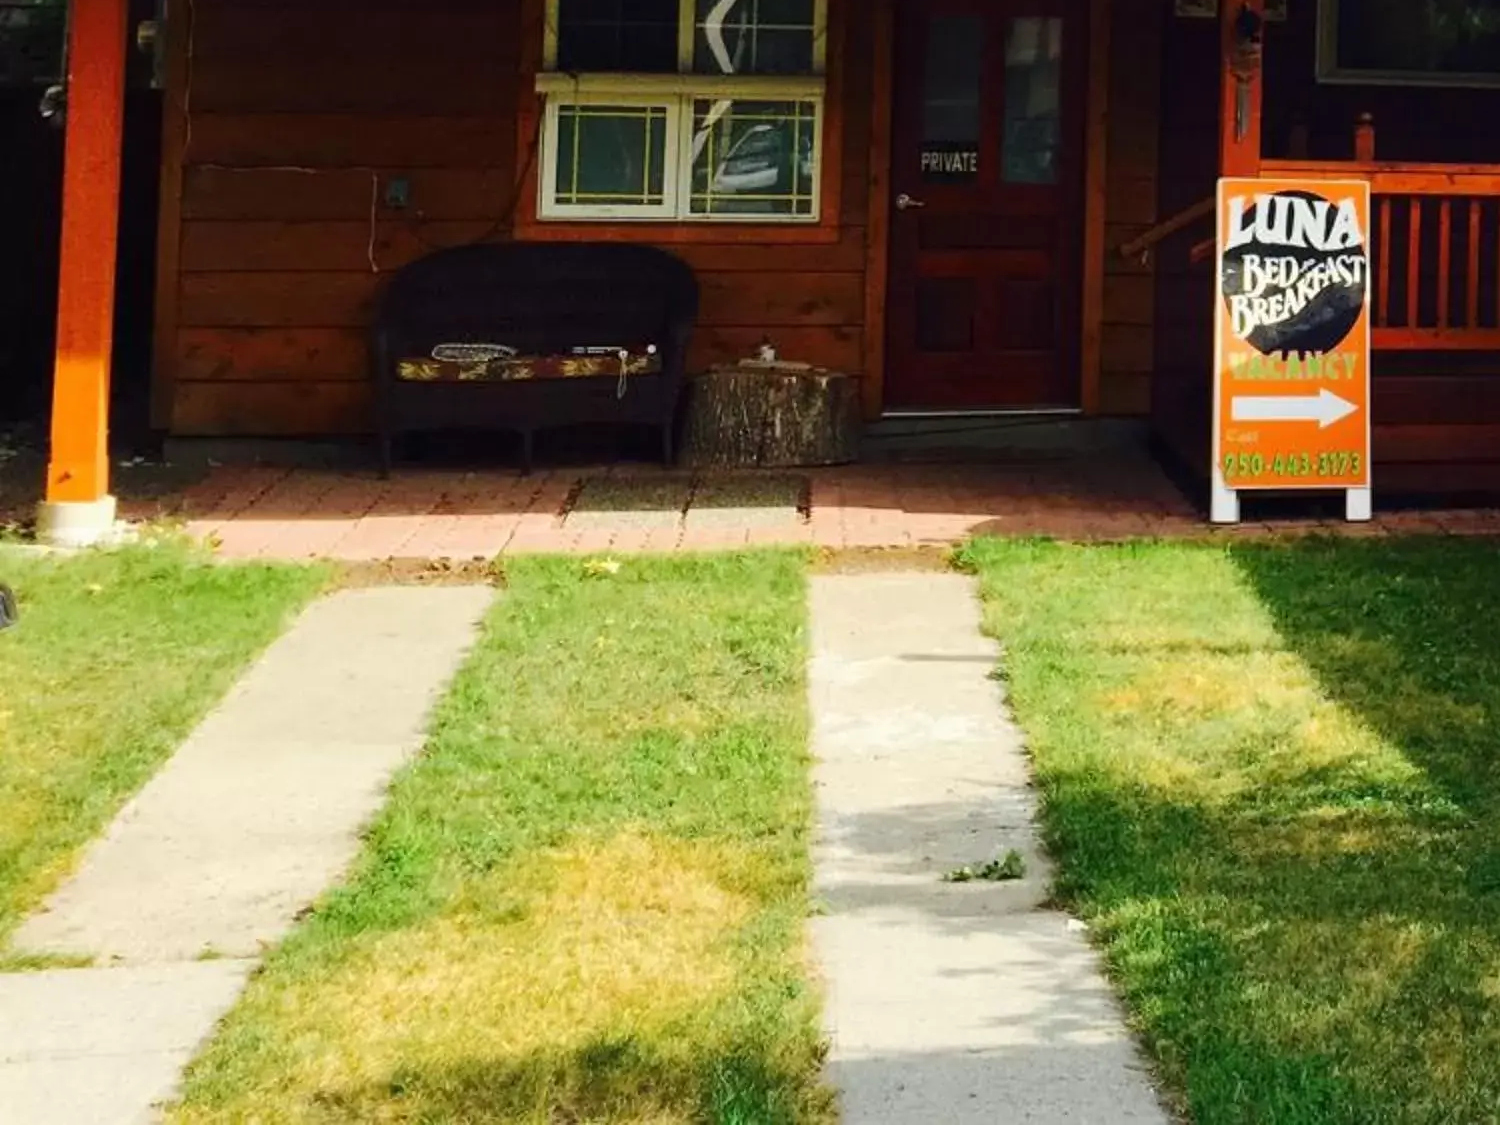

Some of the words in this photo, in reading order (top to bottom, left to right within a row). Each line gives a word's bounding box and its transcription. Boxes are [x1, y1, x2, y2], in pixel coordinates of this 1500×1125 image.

[921, 152, 978, 172] PRIVATE
[1226, 193, 1362, 252] LUNA
[1229, 255, 1366, 339] BREAKFAST
[1242, 254, 1298, 297] BED
[1228, 350, 1358, 381] VACANCY
